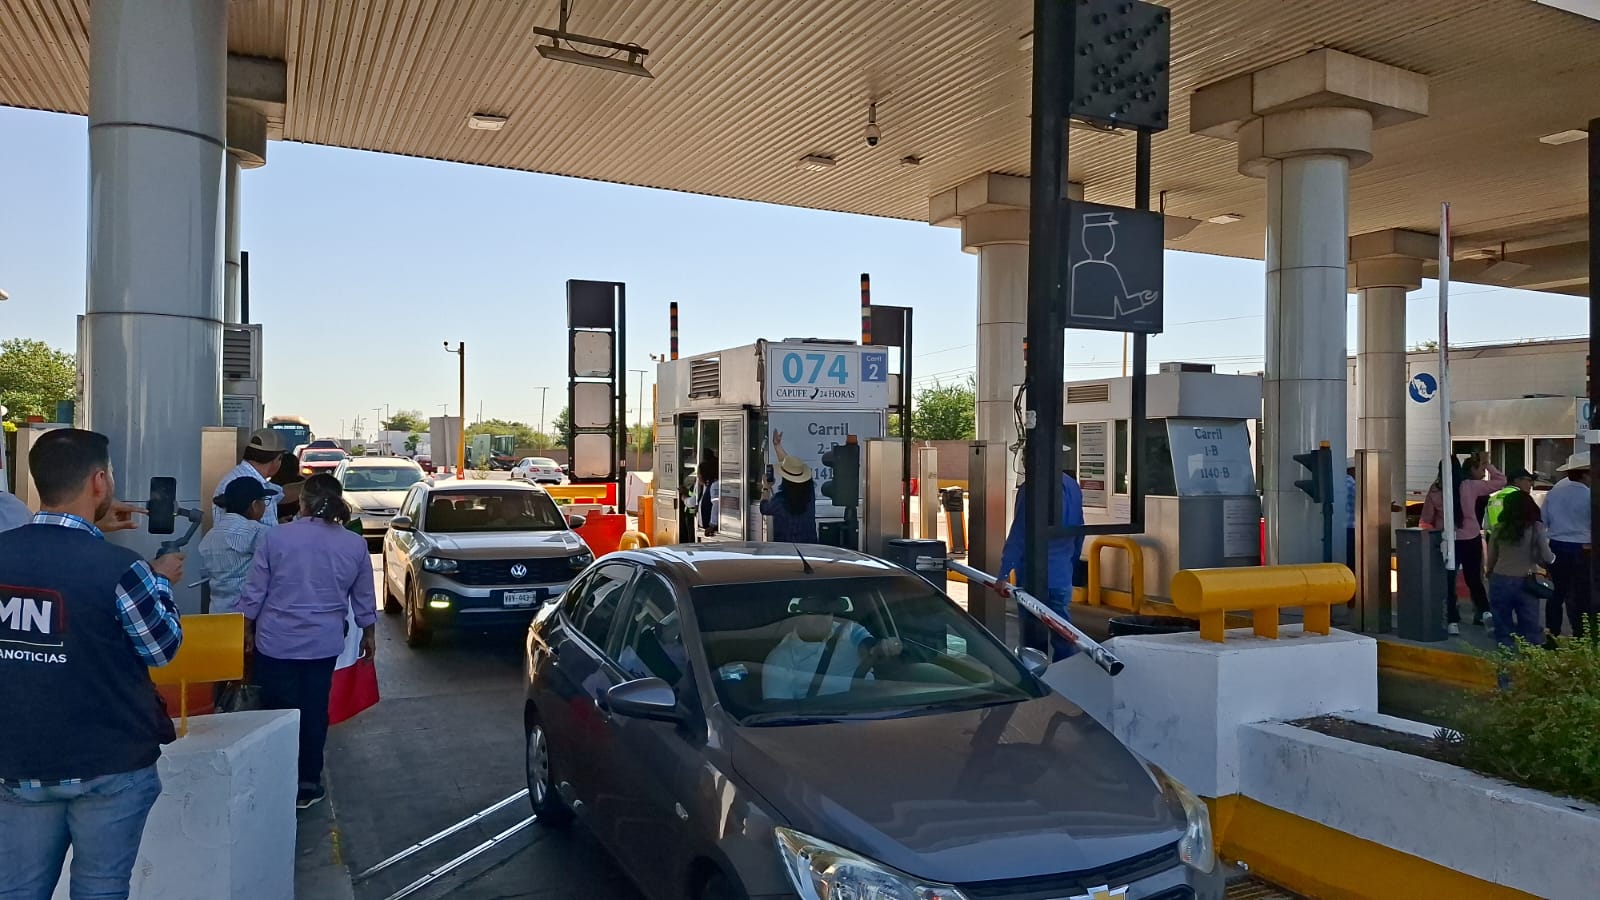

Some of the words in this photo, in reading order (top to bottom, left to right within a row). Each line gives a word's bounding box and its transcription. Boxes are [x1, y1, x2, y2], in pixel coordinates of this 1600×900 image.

[782, 352, 848, 385] 074
[869, 364, 878, 380] 2
[776, 389, 808, 398] CAPUFE
[829, 390, 855, 398] HORAS
[807, 422, 849, 436] Carril
[1194, 429, 1222, 440] Carril
[1204, 446, 1219, 457] 1-B
[1200, 466, 1231, 479] 1140-B
